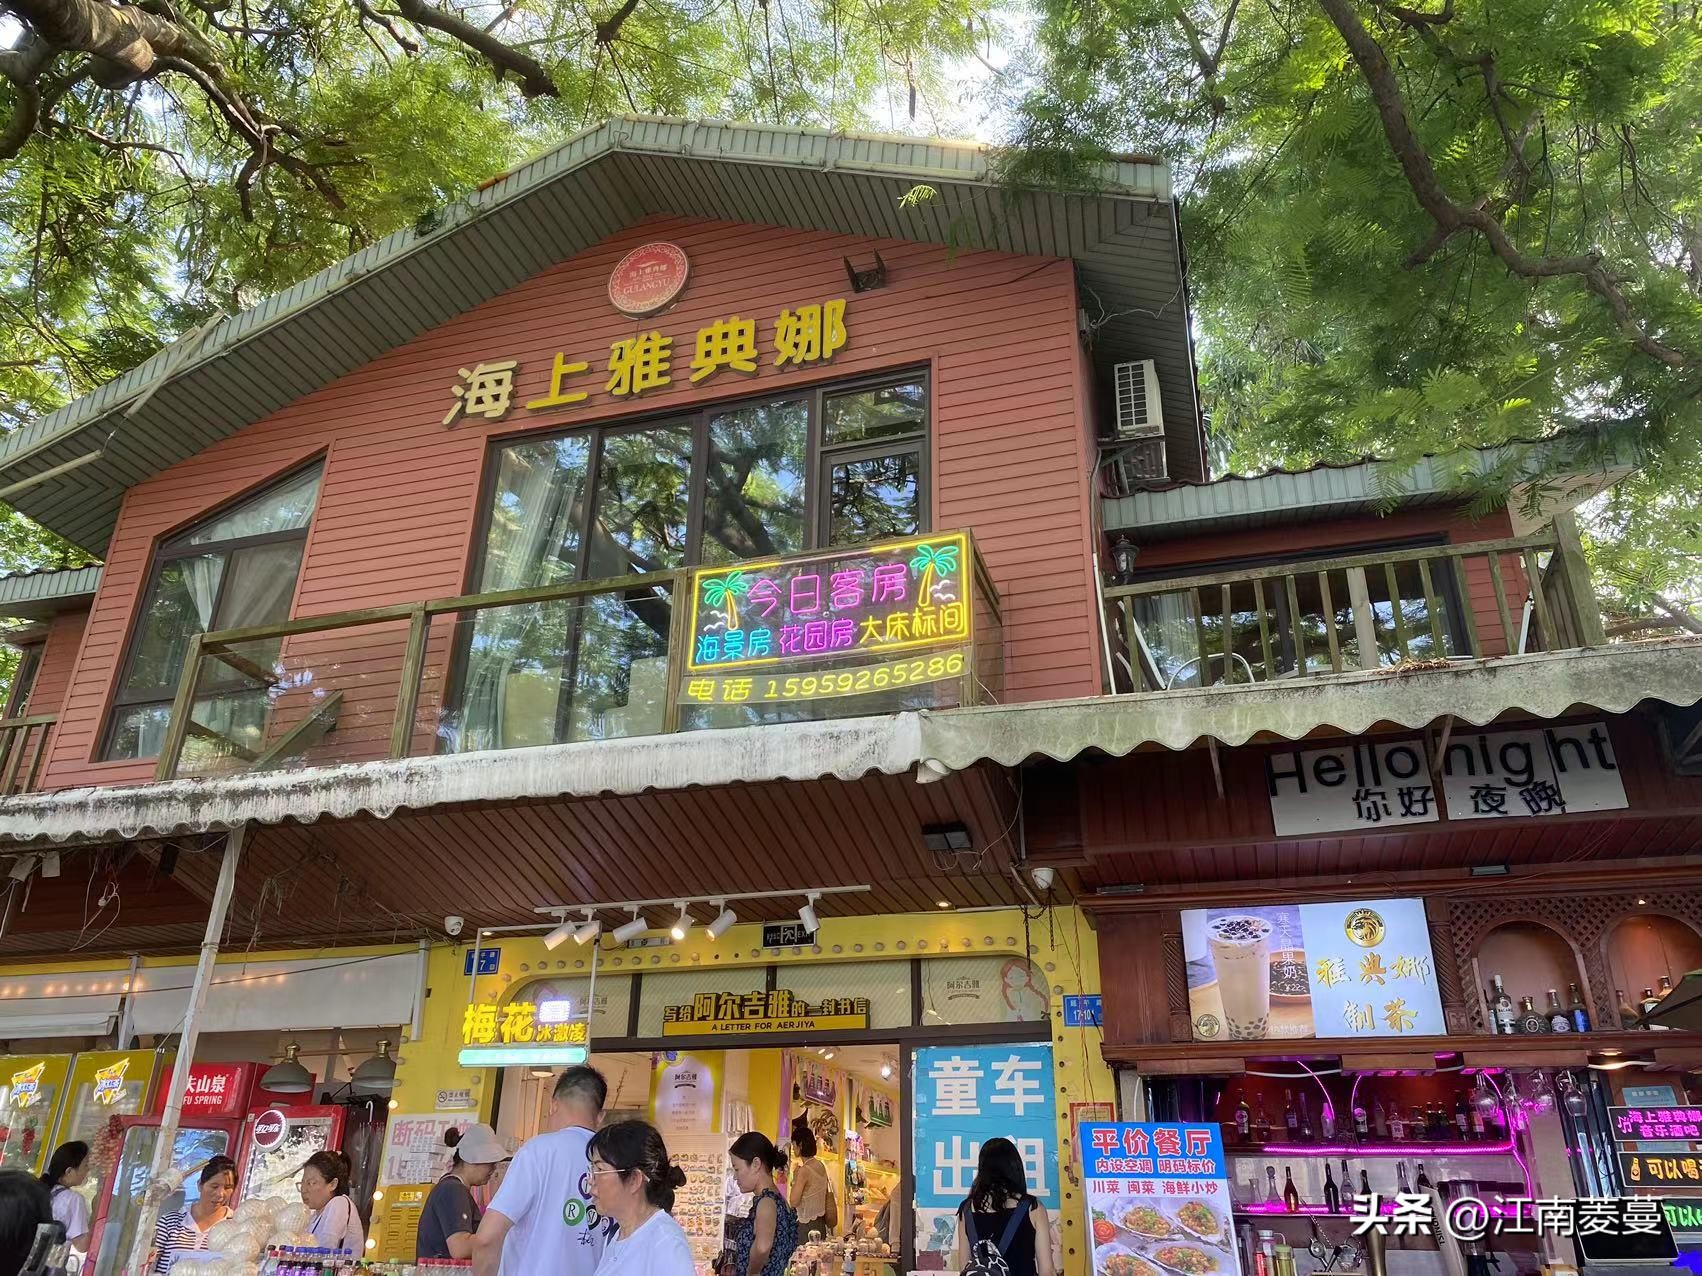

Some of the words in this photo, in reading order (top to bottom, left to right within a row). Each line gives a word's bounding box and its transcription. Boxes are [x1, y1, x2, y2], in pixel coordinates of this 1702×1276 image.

[442, 298, 847, 427] 海上雅典娜
[747, 563, 908, 618] 今日客房
[696, 627, 772, 664] 海景房
[778, 618, 856, 655] 花园房
[859, 601, 966, 645] 大床标间
[687, 677, 752, 702] 电话
[765, 653, 965, 699] 15959265286
[1268, 739, 1420, 796] Hello
[1443, 727, 1616, 787] night
[1352, 785, 1434, 822] 你好
[1470, 779, 1567, 816] 夜晚
[1316, 951, 1430, 988] 雅典娜
[463, 1002, 535, 1044] 梅花
[721, 1023, 751, 1031] LETTER
[776, 1020, 815, 1029] AERJIYA
[194, 1095, 223, 1105] SPRING
[929, 1055, 1044, 1116] 童车
[1092, 1128, 1212, 1156] 平价餐厅
[1640, 1124, 1700, 1138] 音乐酒吧
[1096, 1159, 1153, 1174] 内设空调
[1158, 1159, 1216, 1174] 明码标价
[1647, 1158, 1702, 1180] 可以喝
[1093, 1181, 1120, 1194] 川菜
[1127, 1181, 1155, 1194] 闽菜
[1162, 1181, 1218, 1195] 海鲜小炒
[1663, 1205, 1702, 1227] 可以
